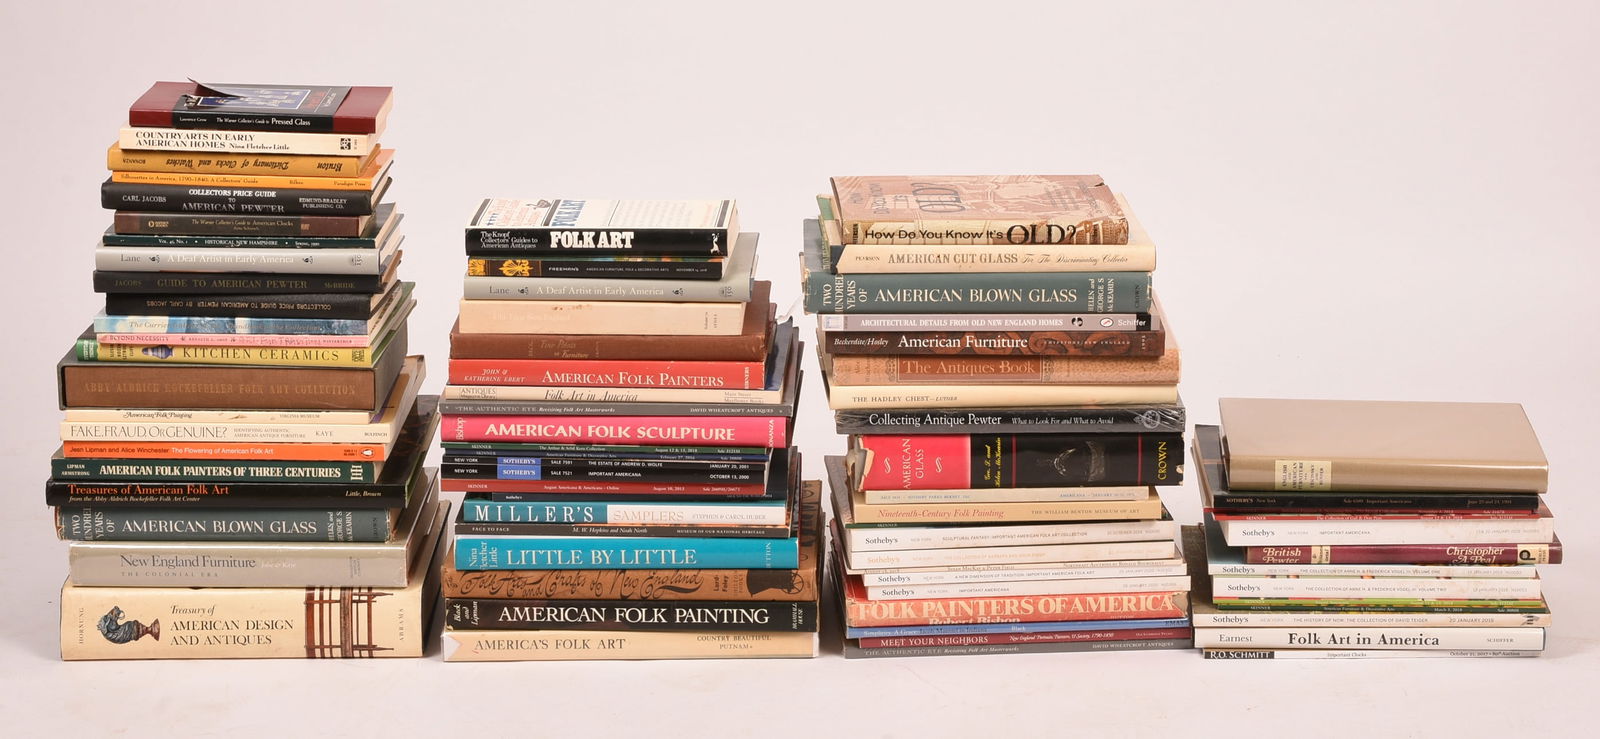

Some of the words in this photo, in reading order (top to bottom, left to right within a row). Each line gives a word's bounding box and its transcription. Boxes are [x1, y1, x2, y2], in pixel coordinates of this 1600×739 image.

[294, 118, 310, 126] Glass
[136, 131, 184, 140] COUNTRY
[185, 132, 208, 140] ARTS
[224, 133, 255, 141] EARLY
[136, 139, 189, 148] AMERICAN
[191, 140, 225, 148] HOMES
[166, 158, 193, 169] Watches
[198, 159, 210, 167] and
[216, 158, 236, 168] Clocks
[241, 159, 249, 167] of
[254, 159, 289, 170] Dictionary
[316, 162, 342, 171] Bruton
[233, 189, 252, 197] PRICE
[242, 204, 284, 213] PEWTER
[865, 230, 896, 239] How
[898, 230, 916, 239] Do
[918, 230, 942, 239] You
[945, 230, 982, 239] Know
[986, 230, 1003, 239] It's
[1007, 224, 1076, 244] OLD?
[550, 231, 595, 248] FOLK
[597, 231, 634, 248] ART
[888, 254, 949, 262] AMERICAN
[953, 254, 976, 262] CUT
[979, 253, 1017, 262] GLASS
[544, 286, 565, 294] Deaf
[569, 286, 591, 295] Artist
[594, 287, 601, 295] in
[604, 287, 626, 296] Early
[629, 287, 663, 295] America
[875, 289, 961, 301] AMERICAN
[970, 288, 1021, 301] BLOWN
[1028, 288, 1076, 301] GLASS
[860, 319, 917, 327] ARCHITECTURAL
[919, 319, 947, 327] DETAILS
[949, 319, 969, 327] FROM
[971, 319, 985, 327] OLD
[987, 319, 1002, 327] NEW
[1005, 319, 1036, 327] ENGLAND
[1038, 319, 1063, 327] HOMES
[1117, 318, 1146, 326] Schiffer
[898, 335, 960, 347] American
[966, 335, 1027, 347] Furniture
[181, 345, 250, 358] KITCHEN
[259, 347, 338, 360] CERAMICS
[542, 371, 613, 383] AMERICAN
[619, 371, 653, 384] FOLK
[659, 373, 723, 385] PAINTERS
[544, 390, 563, 399] Folk
[567, 391, 583, 400] Art
[587, 391, 596, 400] in
[599, 391, 638, 401] America
[869, 413, 920, 426] Collecting
[923, 414, 965, 426] Antique
[967, 413, 1003, 424] Pewter
[456, 417, 465, 439] Bishop
[485, 423, 580, 436] AMERICAN
[588, 425, 629, 437] FOLK
[637, 426, 735, 439] SCULPTURE
[184, 448, 213, 456] Flowering
[902, 438, 911, 489] AMERICAN
[915, 448, 925, 478] GLASS
[1157, 441, 1166, 480] CROWN
[98, 463, 151, 474] AMERICAN
[155, 466, 180, 474] FOLK
[183, 463, 231, 475] PAINTERS
[233, 464, 248, 475] OF
[248, 467, 282, 476] THREE
[283, 465, 340, 477] CENTURIES
[501, 468, 535, 476] SOTHEBY'S
[67, 483, 117, 494] Treasures
[120, 483, 131, 494] of
[136, 483, 183, 494] American
[187, 483, 207, 494] Folk
[214, 483, 228, 494] Art
[474, 505, 592, 524] MILLER'S
[972, 509, 1003, 518] Painting
[122, 520, 205, 532] AMERICAN
[213, 520, 263, 532] BLOWN
[269, 521, 316, 532] GLASS
[865, 536, 897, 544] Sotheby's
[507, 549, 582, 564] LITTLE
[591, 549, 613, 563] BY
[620, 549, 695, 563] LITTLE
[1262, 547, 1301, 556] British
[1446, 546, 1504, 557] Christopher
[120, 554, 146, 566] New
[151, 554, 198, 568] England
[202, 555, 255, 567] Furniture
[1222, 566, 1254, 576] Sotheby's
[882, 588, 914, 596] Sotheby's
[1227, 584, 1260, 592] Sotheby's
[170, 605, 204, 615] Treasury
[207, 605, 214, 615] of
[859, 601, 917, 621] FOLK
[921, 597, 1033, 618] PAINTERS
[1038, 596, 1068, 614] OF
[1069, 594, 1174, 614] AMERICA
[499, 607, 605, 621] AMERICAN
[615, 607, 666, 622] FOLK
[675, 608, 768, 623] PAINTING
[1212, 616, 1248, 624] Sotheby's
[170, 620, 238, 630] AMERICAN
[246, 620, 292, 629] DESIGN
[170, 635, 198, 644] AND
[204, 635, 271, 645] ANTIQUES
[880, 638, 903, 646] MEET
[937, 636, 987, 644] NEIGHBORS
[1288, 632, 1320, 643] Folk
[1327, 633, 1349, 644] Art
[1377, 633, 1438, 644] America
[476, 639, 548, 649] AMERICA'S
[555, 639, 589, 648] FOLK
[598, 638, 625, 648] ART
[1209, 651, 1226, 659] R.O.
[1227, 651, 1271, 659] SCHMITT
